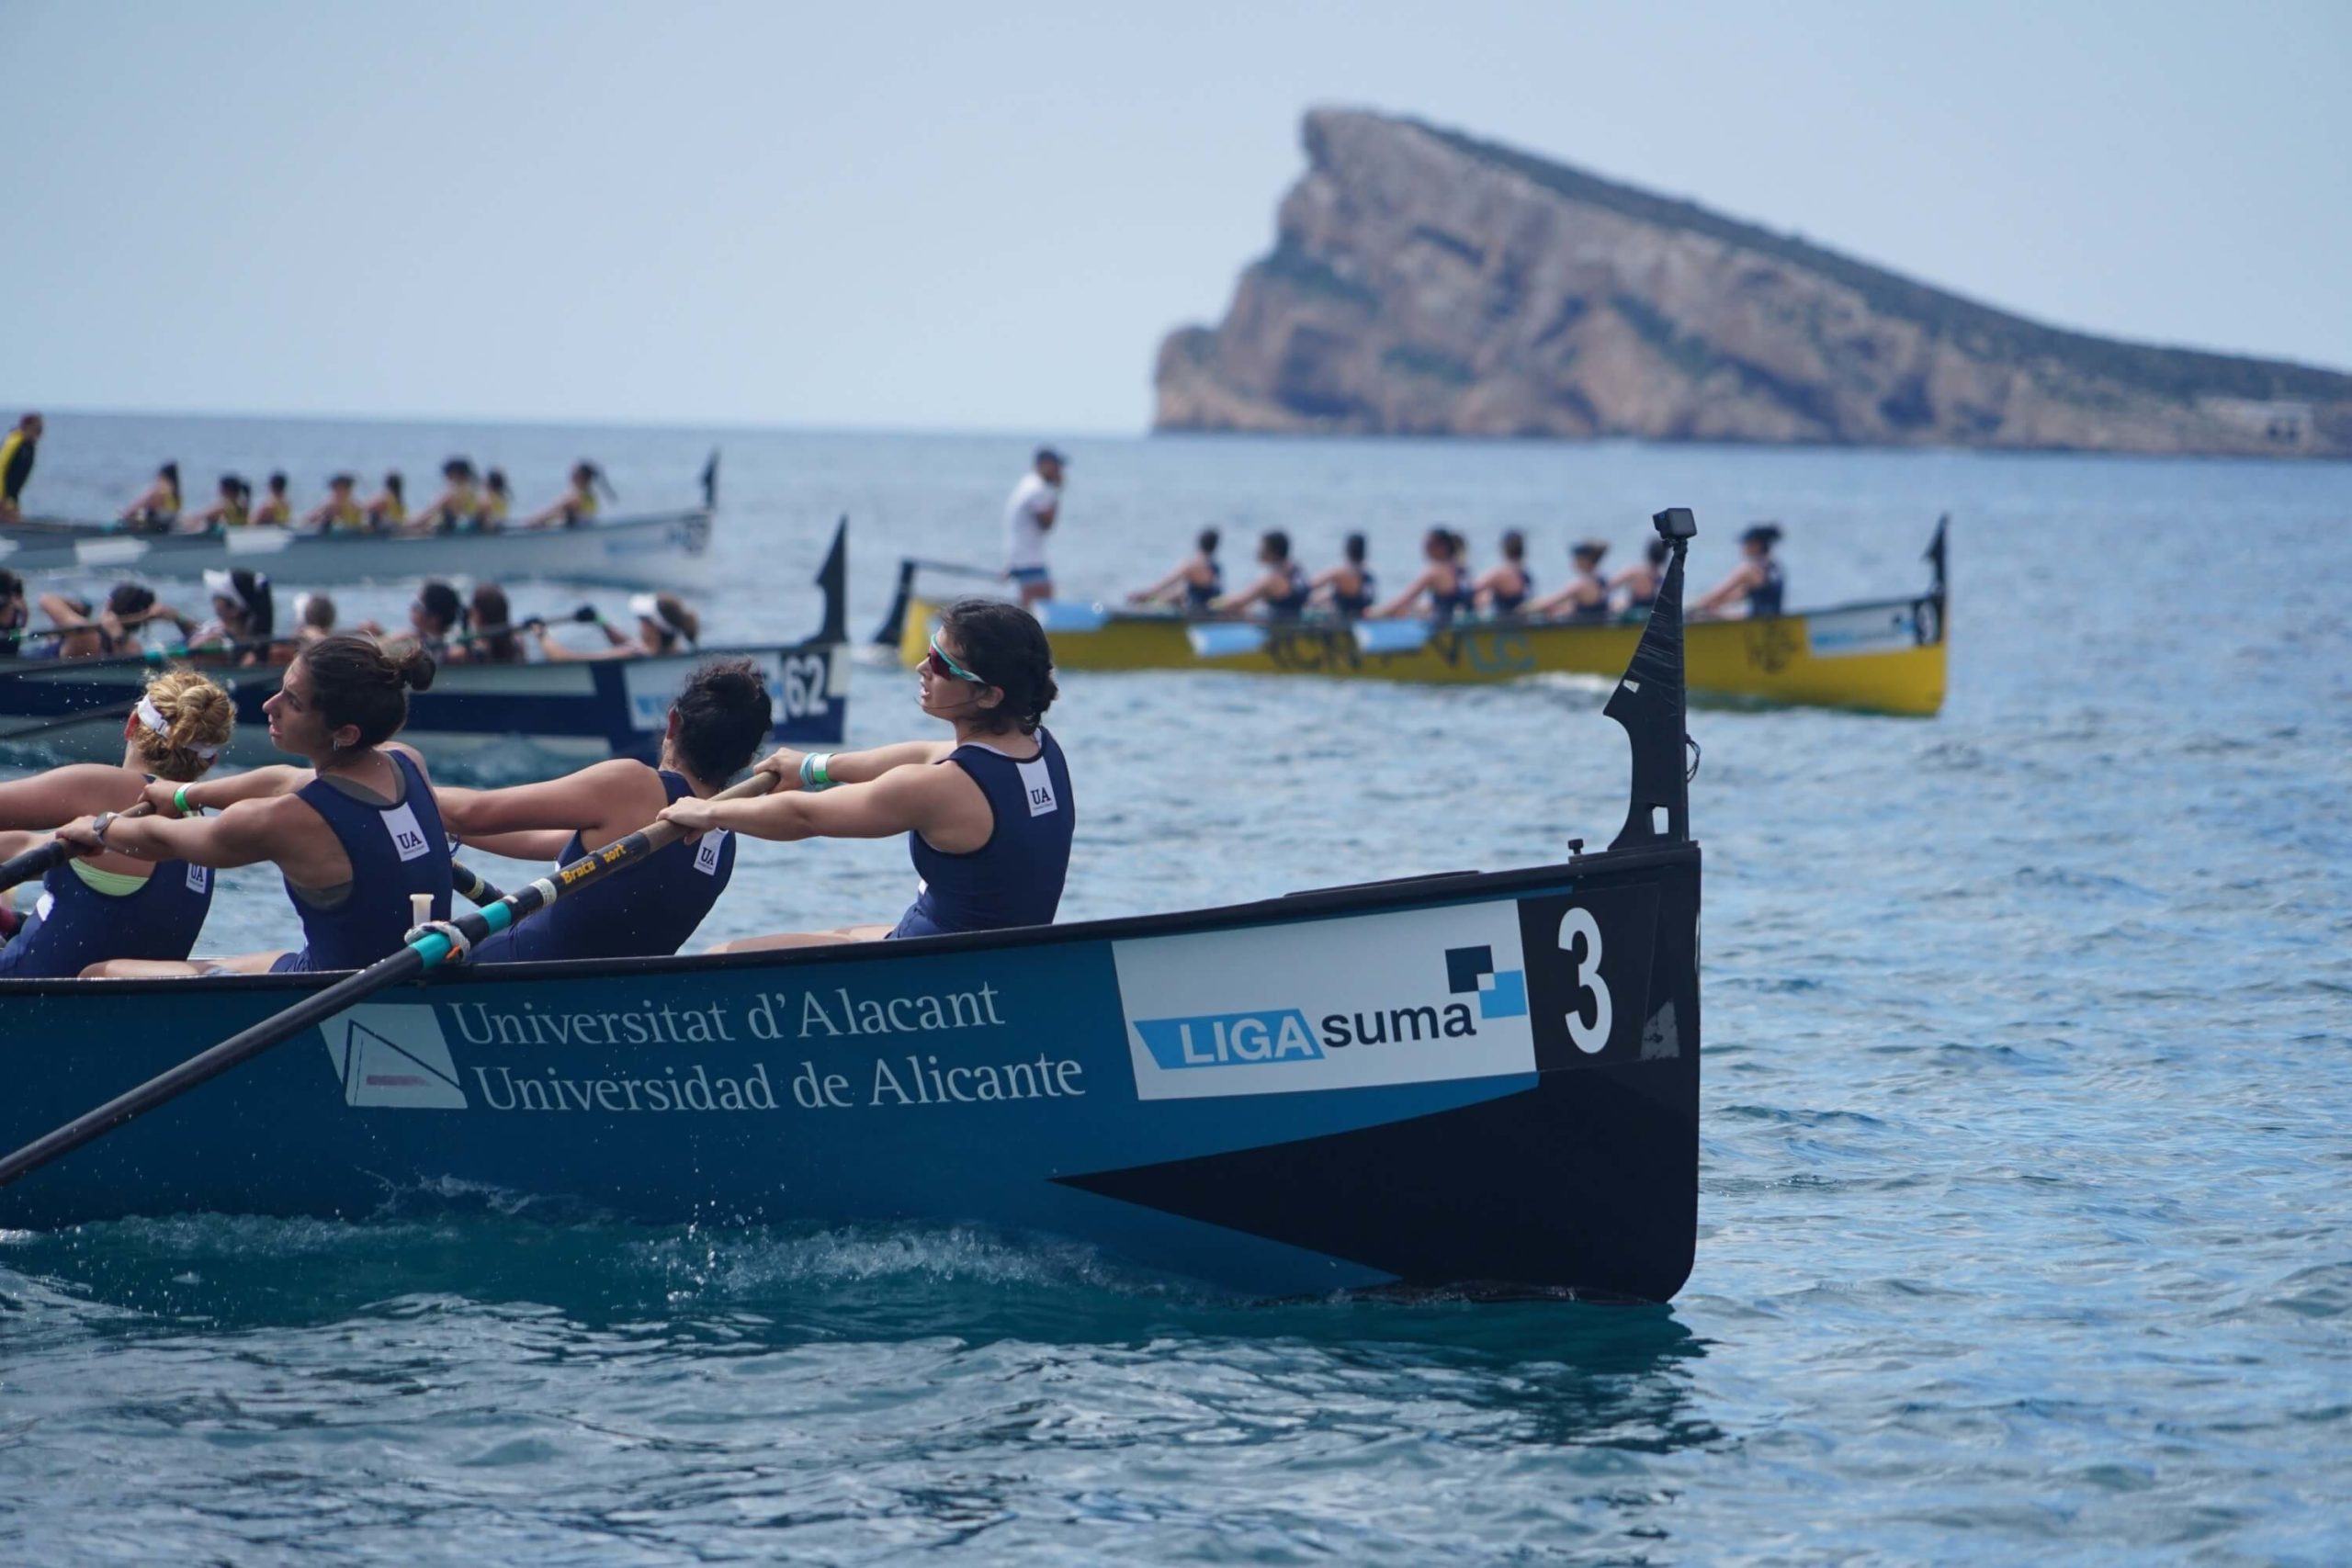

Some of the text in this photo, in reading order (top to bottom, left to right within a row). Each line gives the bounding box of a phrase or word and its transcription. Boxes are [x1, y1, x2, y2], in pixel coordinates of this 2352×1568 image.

[785, 653, 828, 718] 62
[1030, 786, 1052, 805] UA
[397, 830, 423, 849] UA
[700, 846, 716, 866] UA
[1558, 907, 1613, 1054] 3
[446, 980, 1007, 1047] Universitat d'Alacant
[1179, 1003, 1478, 1066] LIGA suma
[469, 1053, 1088, 1112] Universidad de Alicante
